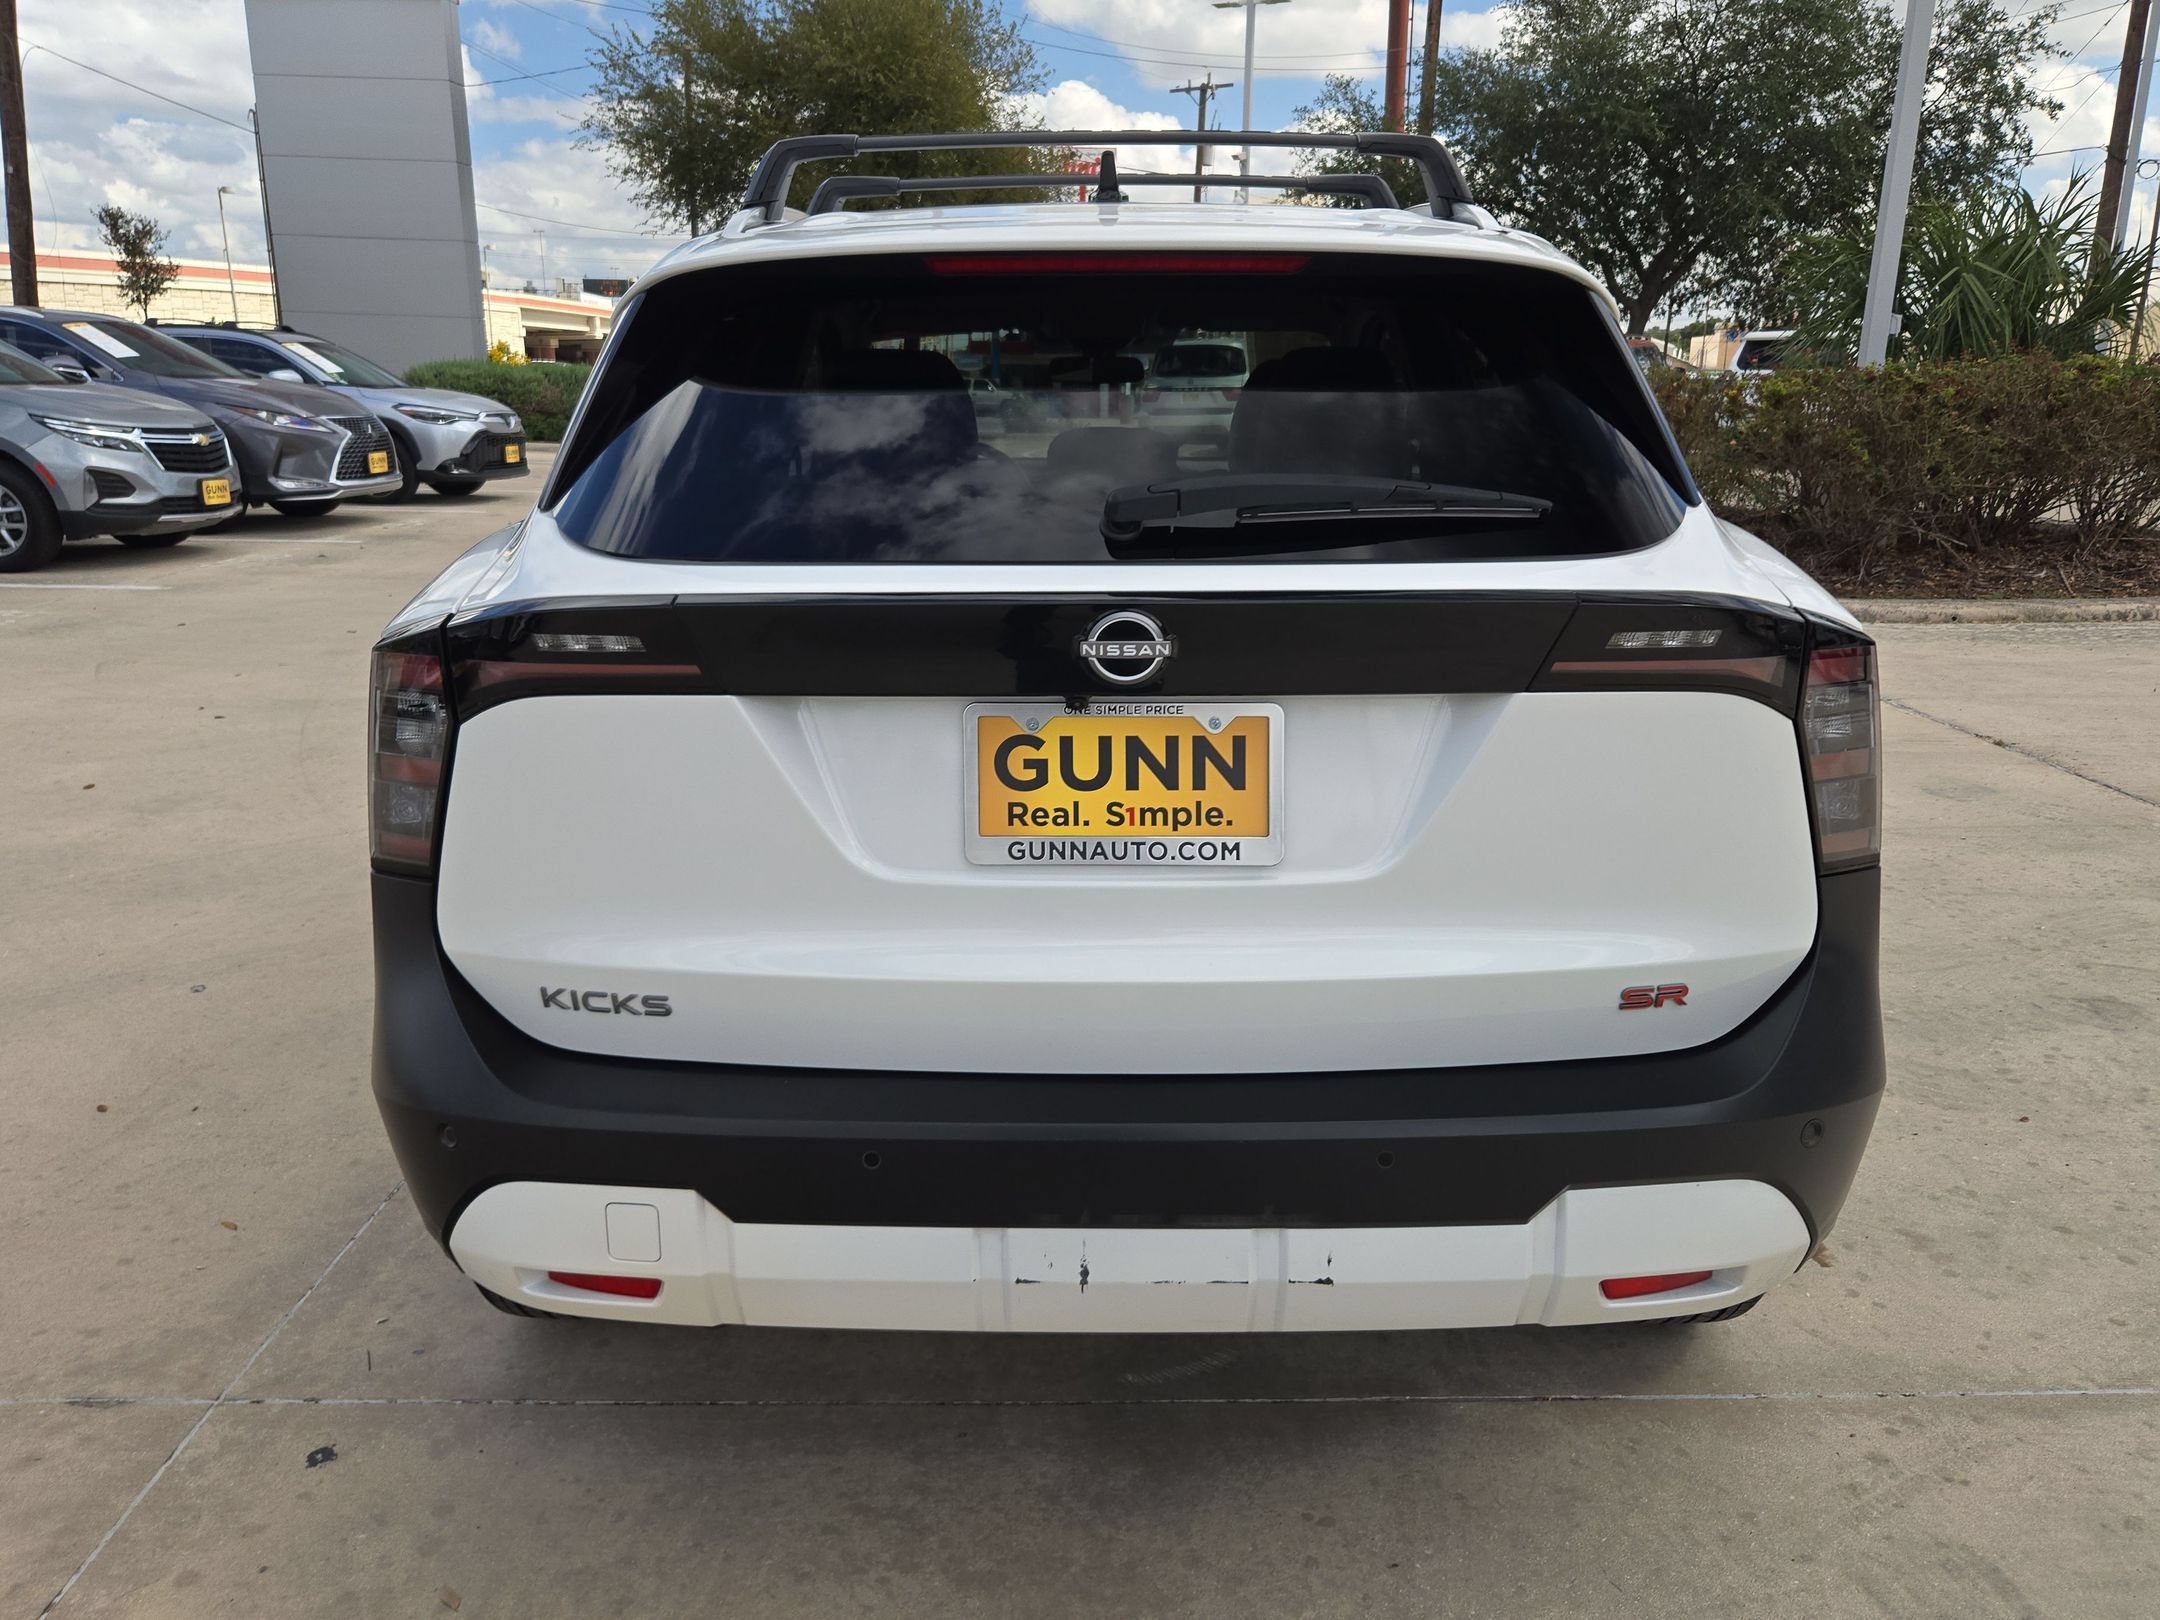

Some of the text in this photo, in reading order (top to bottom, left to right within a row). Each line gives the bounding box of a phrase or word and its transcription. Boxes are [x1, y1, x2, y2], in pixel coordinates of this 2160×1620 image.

[205, 484, 228, 495] GUNN
[1082, 644, 1170, 656] NISSAN
[1095, 705, 1141, 715] SIMPLE
[1145, 705, 1184, 715] PRICE
[994, 734, 1246, 792] GUNN
[1007, 801, 1090, 827] Real.
[1007, 841, 1241, 861] GUNNAUTO.COM
[540, 986, 673, 1017] KICKS
[1618, 983, 1689, 1010] SR
